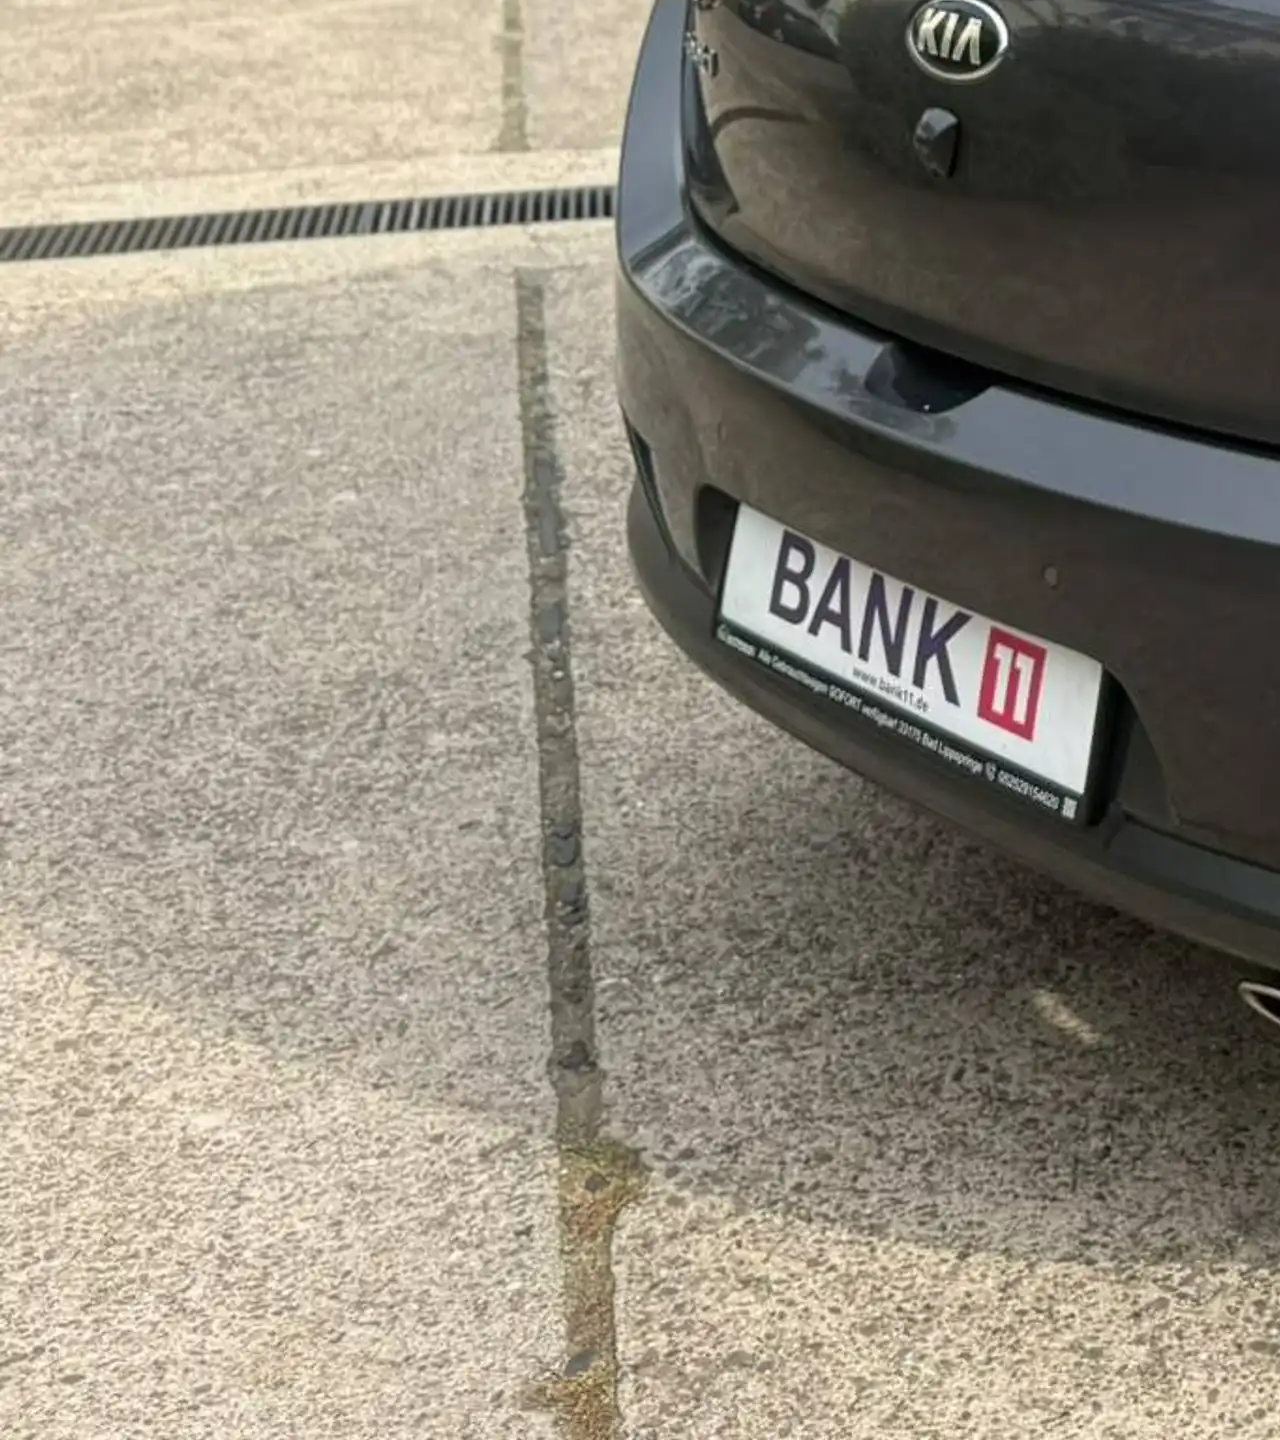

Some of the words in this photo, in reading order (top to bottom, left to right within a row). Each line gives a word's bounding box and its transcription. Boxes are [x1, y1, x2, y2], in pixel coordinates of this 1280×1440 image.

[916, 6, 984, 67] KIA
[768, 528, 973, 709] BANK
[989, 639, 1035, 728] 11
